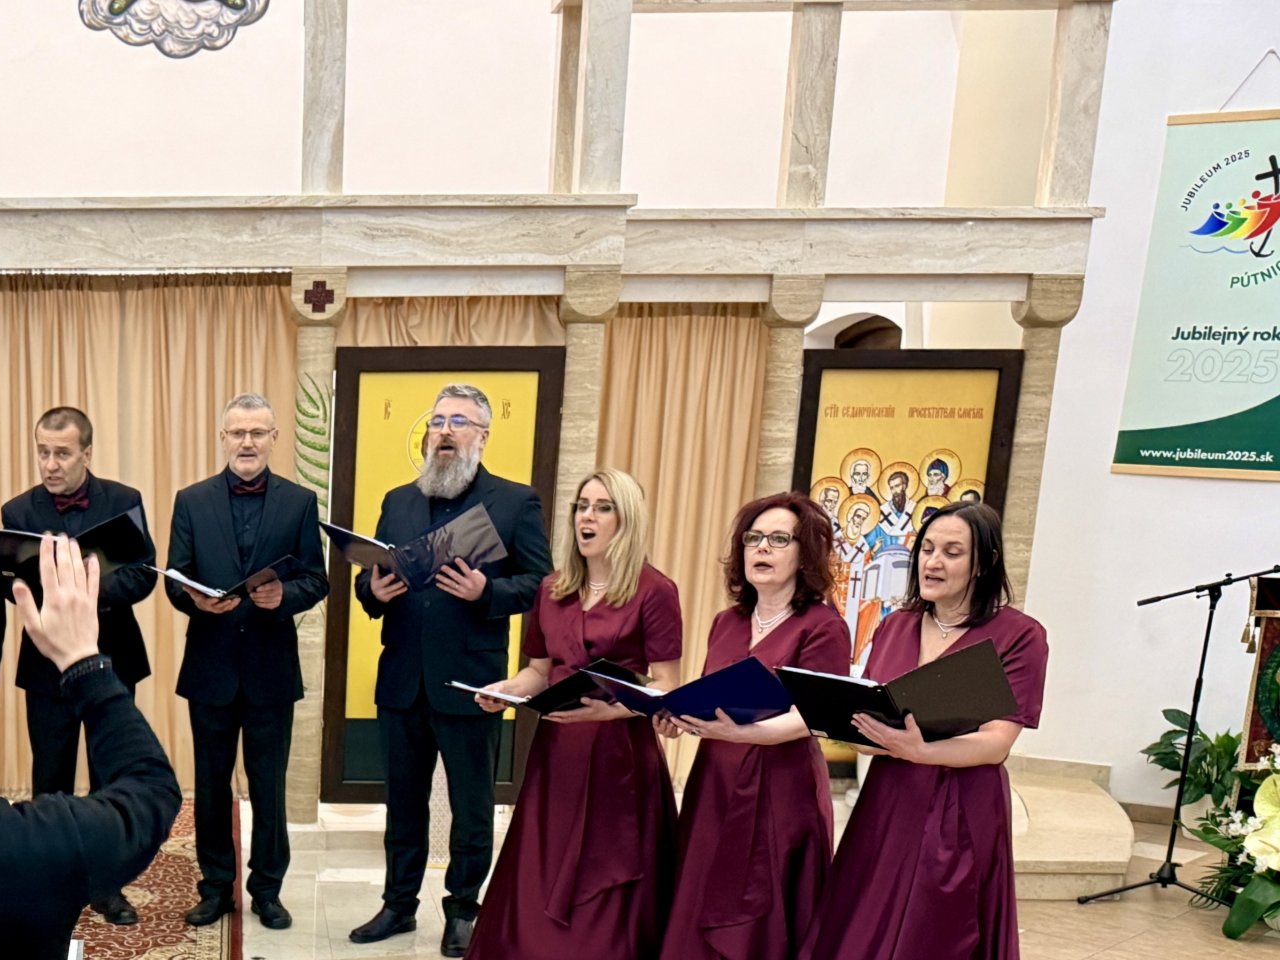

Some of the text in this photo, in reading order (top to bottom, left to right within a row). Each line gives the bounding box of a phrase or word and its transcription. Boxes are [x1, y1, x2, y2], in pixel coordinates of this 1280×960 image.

[1180, 149, 1250, 212] JUBILEUM 2025
[1171, 325, 1280, 345] Jubilejný rok
[1163, 348, 1280, 384] 2025
[1140, 448, 1274, 462] www.jubileum2025.sk
